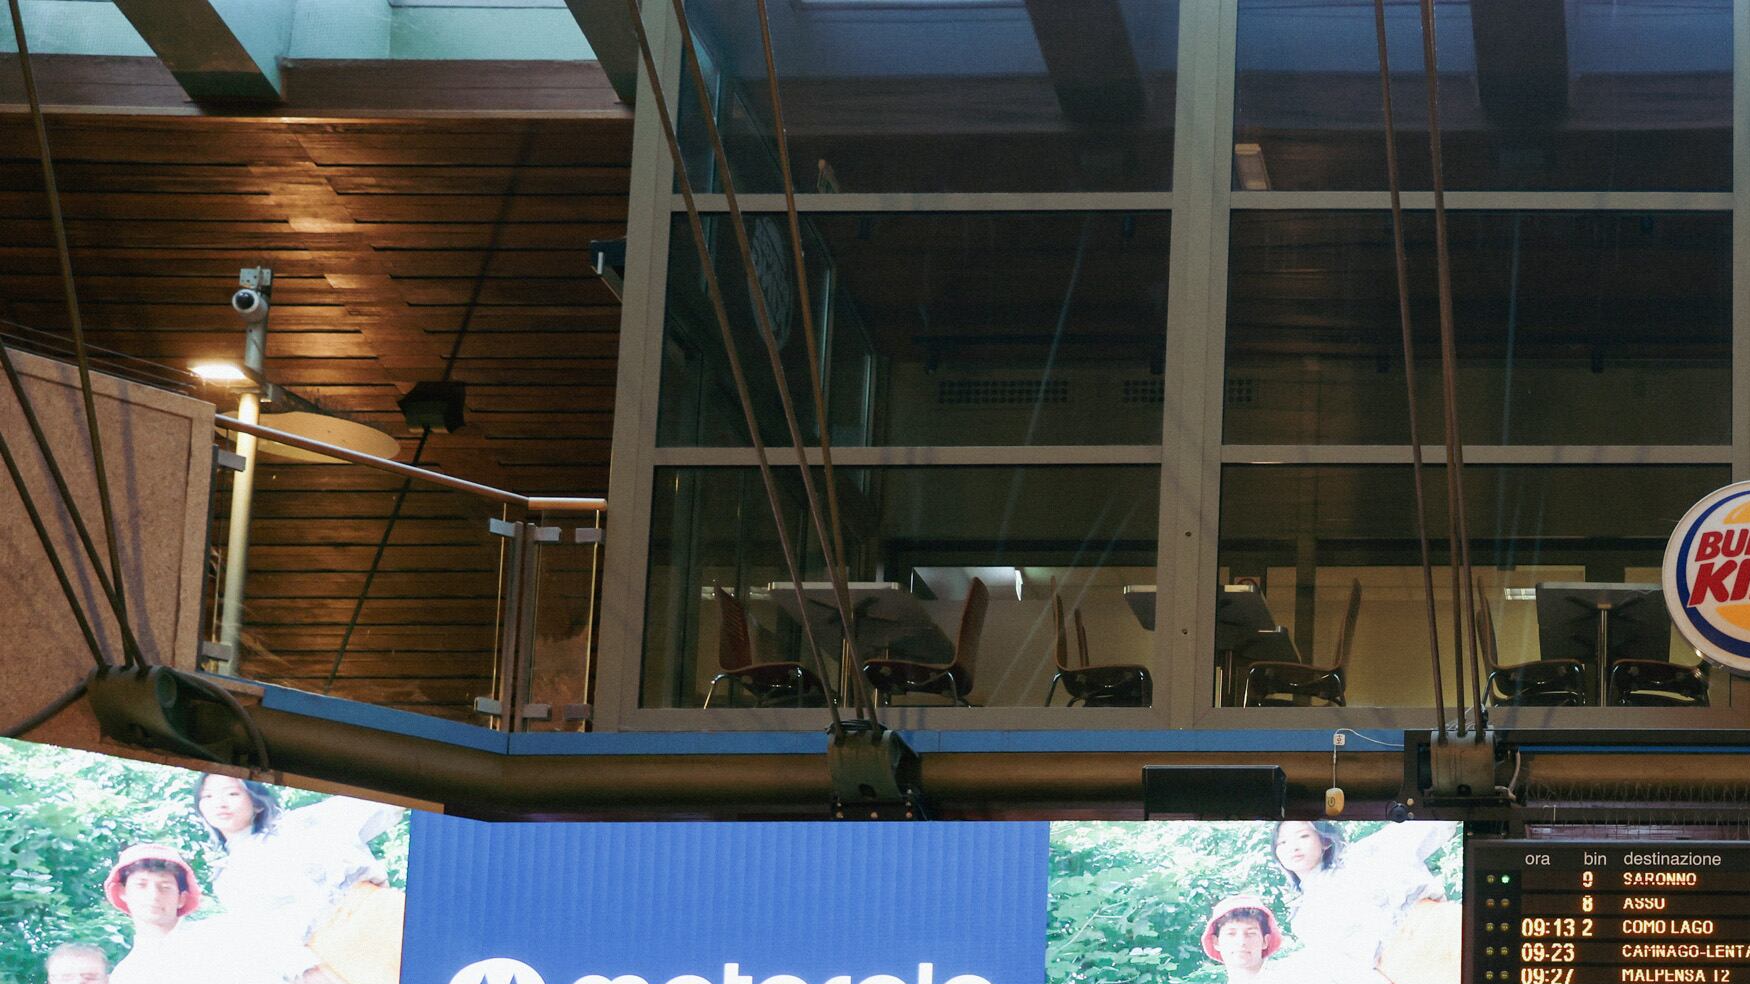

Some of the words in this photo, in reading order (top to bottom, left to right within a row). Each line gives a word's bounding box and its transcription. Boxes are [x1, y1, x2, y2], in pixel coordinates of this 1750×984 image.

[1525, 854, 1550, 866] ora
[1584, 852, 1607, 866] bin
[1624, 852, 1722, 866] destinazione
[1623, 872, 1697, 885] SARONNO
[1521, 918, 1575, 937] 09:13
[1582, 919, 1593, 937] 2
[1622, 920, 1666, 934] COMO
[1671, 920, 1714, 934] LAGO
[1521, 943, 1575, 962] 09:23
[1622, 969, 1705, 983] MALPENSA
